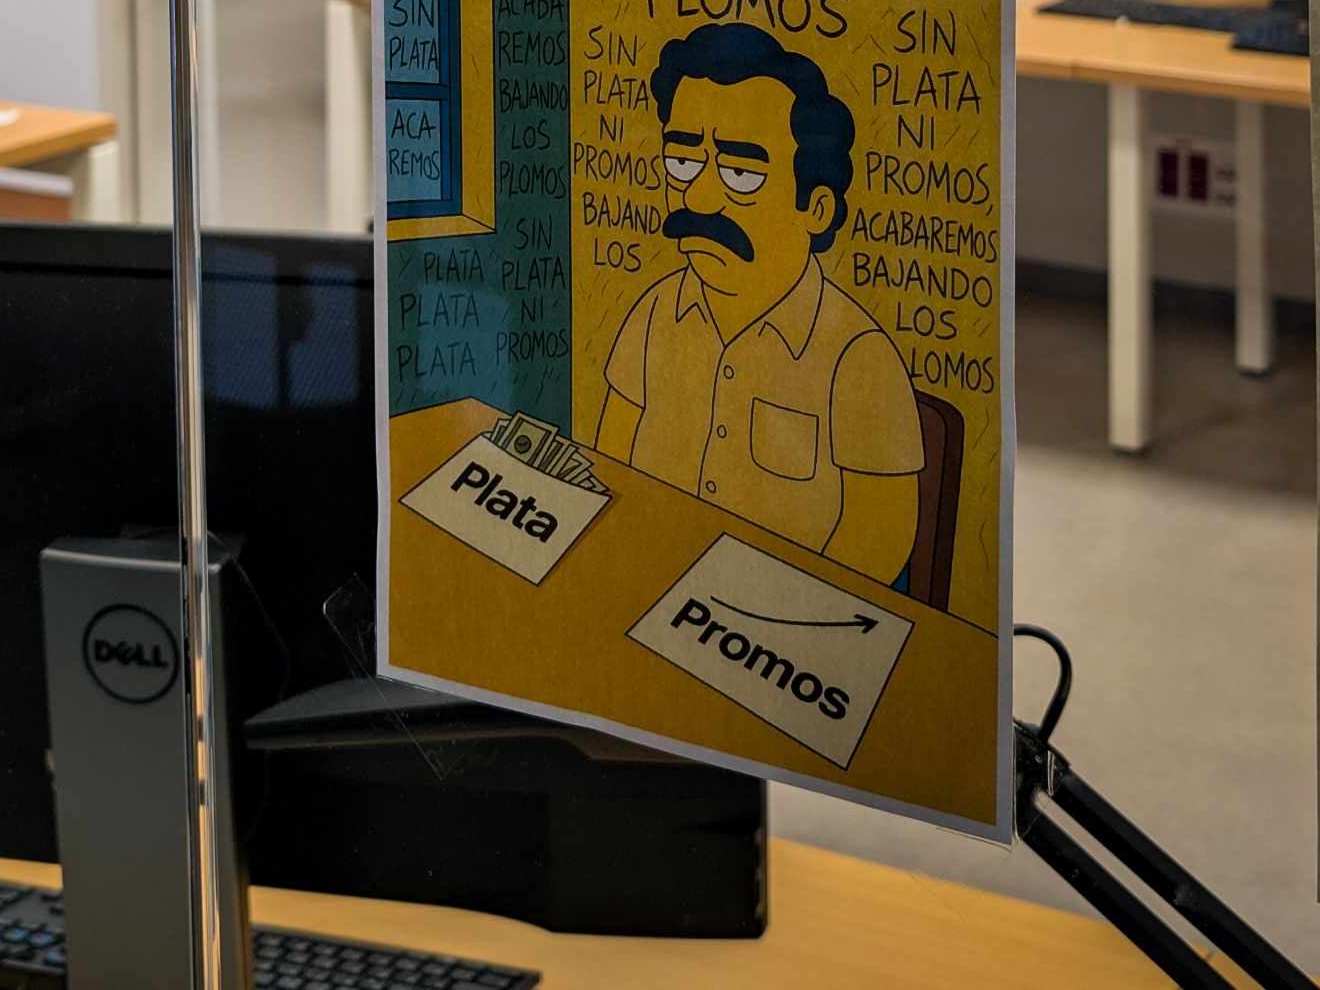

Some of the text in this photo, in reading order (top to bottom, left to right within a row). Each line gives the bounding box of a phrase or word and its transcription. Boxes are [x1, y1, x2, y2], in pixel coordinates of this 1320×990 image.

[498, 30, 566, 70] REMOS
[584, 25, 637, 66] SIN
[894, 10, 955, 56] SIN
[389, 36, 438, 71] PLATA
[499, 78, 567, 112] BAJANDO
[584, 70, 648, 111] PLATA
[873, 63, 981, 114] PLATA
[512, 119, 550, 150] LOS
[600, 114, 623, 144] NI
[898, 114, 934, 150] NI
[389, 149, 440, 180] REMOS
[500, 162, 566, 199] PLOMOS
[574, 142, 661, 190] PROMOS
[866, 151, 993, 216] PROMOS,
[513, 213, 552, 250] SIN
[851, 208, 997, 263] ACABAREMOS
[424, 249, 483, 285] PLATA
[502, 256, 565, 291] PLATA
[594, 238, 641, 272] LOS
[853, 252, 992, 308] BAJANDO
[401, 293, 479, 331] PLATA
[522, 298, 543, 323] NI
[896, 301, 957, 340] LOS
[397, 342, 475, 382] PLATA
[497, 329, 568, 365] PROMOS
[450, 460, 558, 544] Plata
[95, 639, 168, 667] DELL
[670, 597, 850, 720] Promos
